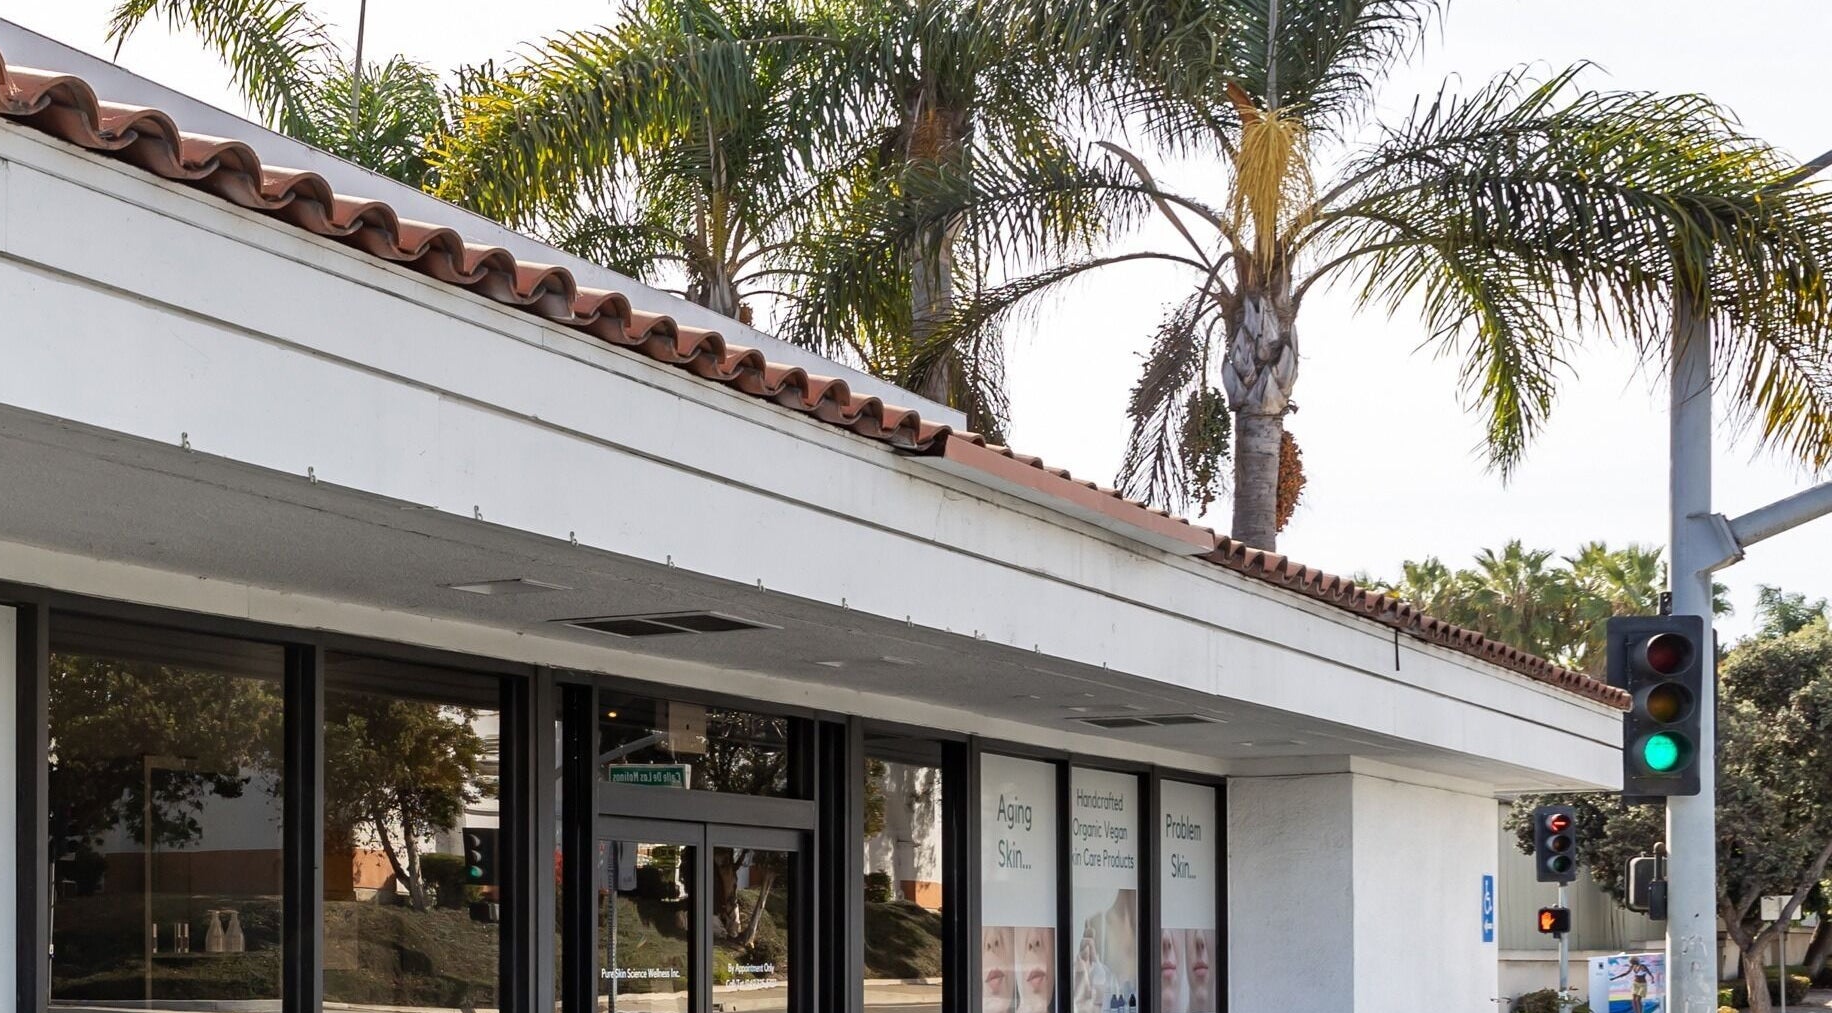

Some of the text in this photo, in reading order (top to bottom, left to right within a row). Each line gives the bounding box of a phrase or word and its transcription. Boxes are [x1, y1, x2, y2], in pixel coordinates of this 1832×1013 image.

[997, 793, 1032, 832] Aging
[1076, 788, 1124, 811] Handcrafted
[1072, 817, 1128, 844] Organic Vegan
[1166, 813, 1201, 841] Problem
[998, 839, 1032, 870] Skin...
[1083, 847, 1101, 867] Care
[1103, 849, 1135, 870] Products
[1171, 853, 1197, 879] Skin...
[601, 968, 614, 979] Pure
[614, 967, 626, 978] Skin
[627, 968, 647, 979] Science
